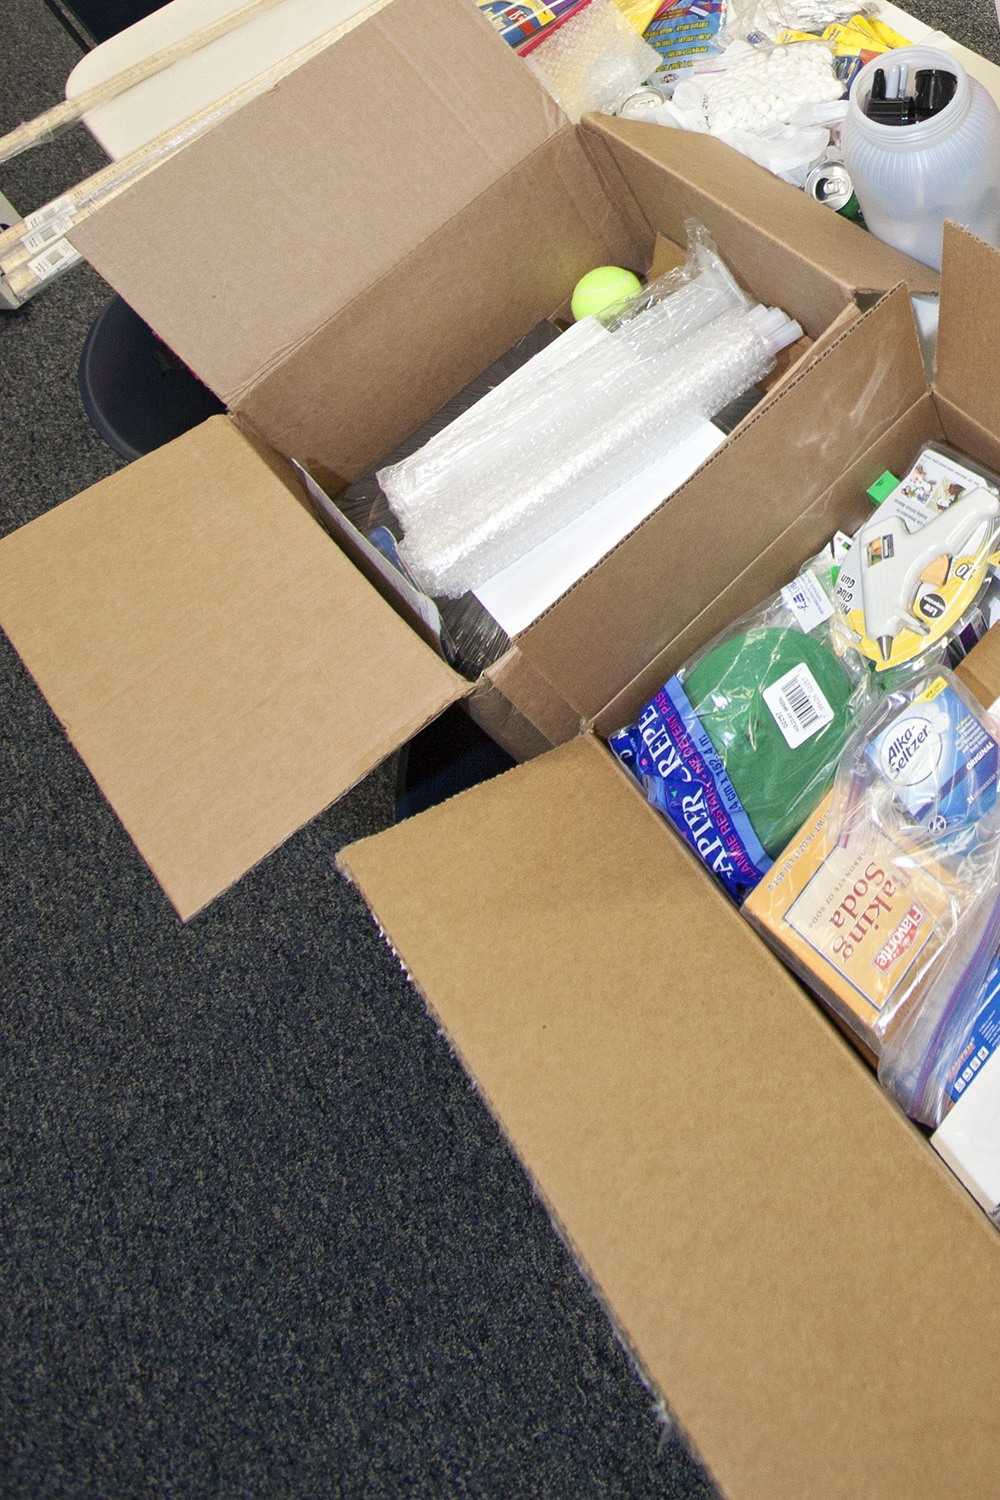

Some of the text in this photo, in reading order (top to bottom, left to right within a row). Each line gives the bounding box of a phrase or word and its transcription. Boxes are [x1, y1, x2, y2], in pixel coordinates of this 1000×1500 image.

[840, 574, 855, 588] Gun
[836, 586, 853, 601] Glue
[923, 603, 937, 616] Low
[653, 692, 670, 714] PAS
[779, 696, 799, 732] HOLIDAY GREEN
[888, 726, 921, 763] Alka-
[688, 756, 703, 774] NE
[966, 742, 993, 770] ORIGINAL
[723, 784, 736, 801] cm
[673, 787, 736, 881] APIER
[814, 819, 825, 832] WT
[799, 841, 809, 852] OZ
[805, 832, 816, 841] 16
[773, 872, 785, 885] 454
[830, 862, 884, 927] Soda
[809, 893, 834, 927] OF SODA
[830, 869, 904, 958] Baking
[874, 907, 920, 969] Flavorite
